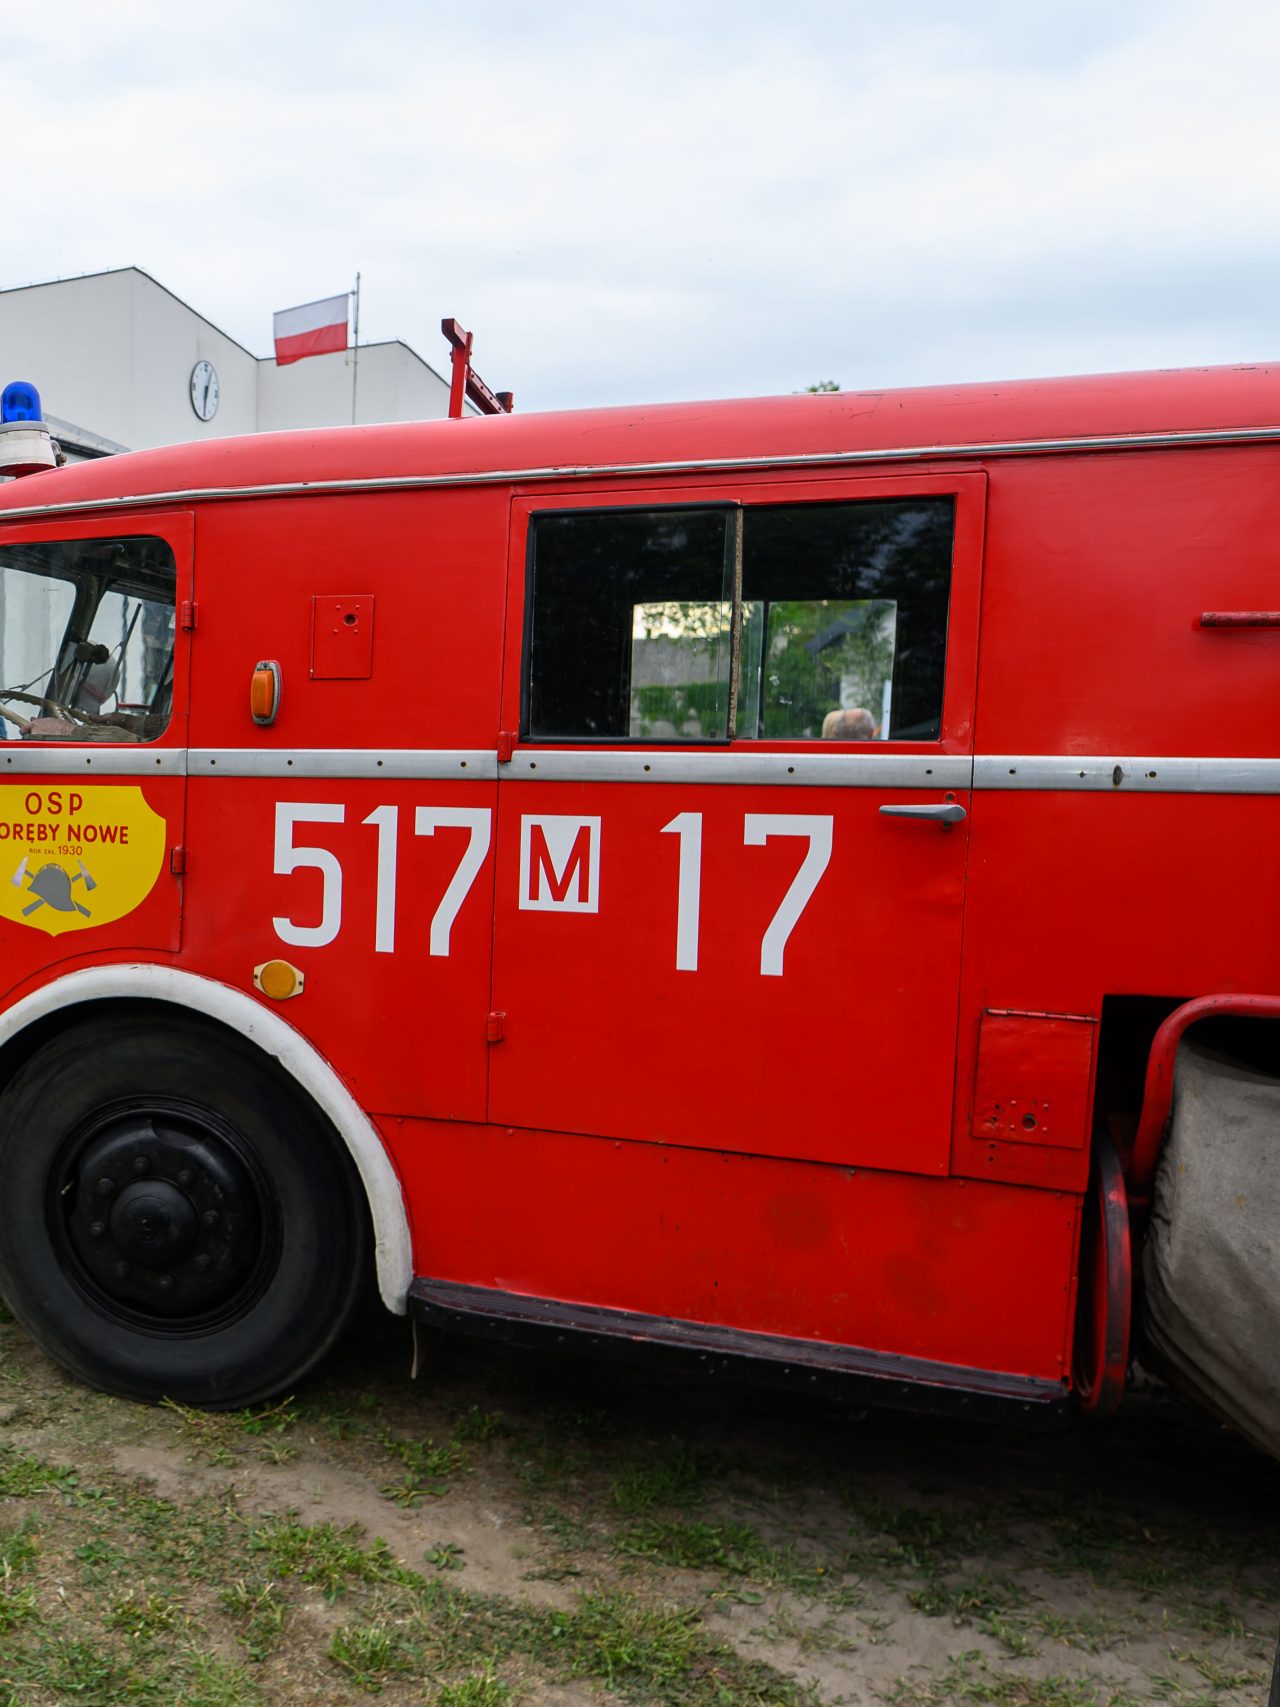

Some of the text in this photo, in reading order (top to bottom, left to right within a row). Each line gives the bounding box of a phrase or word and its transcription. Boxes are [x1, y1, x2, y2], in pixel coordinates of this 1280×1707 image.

[24, 791, 83, 816] OSP
[67, 824, 129, 845] NOWE
[58, 844, 83, 856] 1930
[272, 801, 834, 977] 517 M 17
